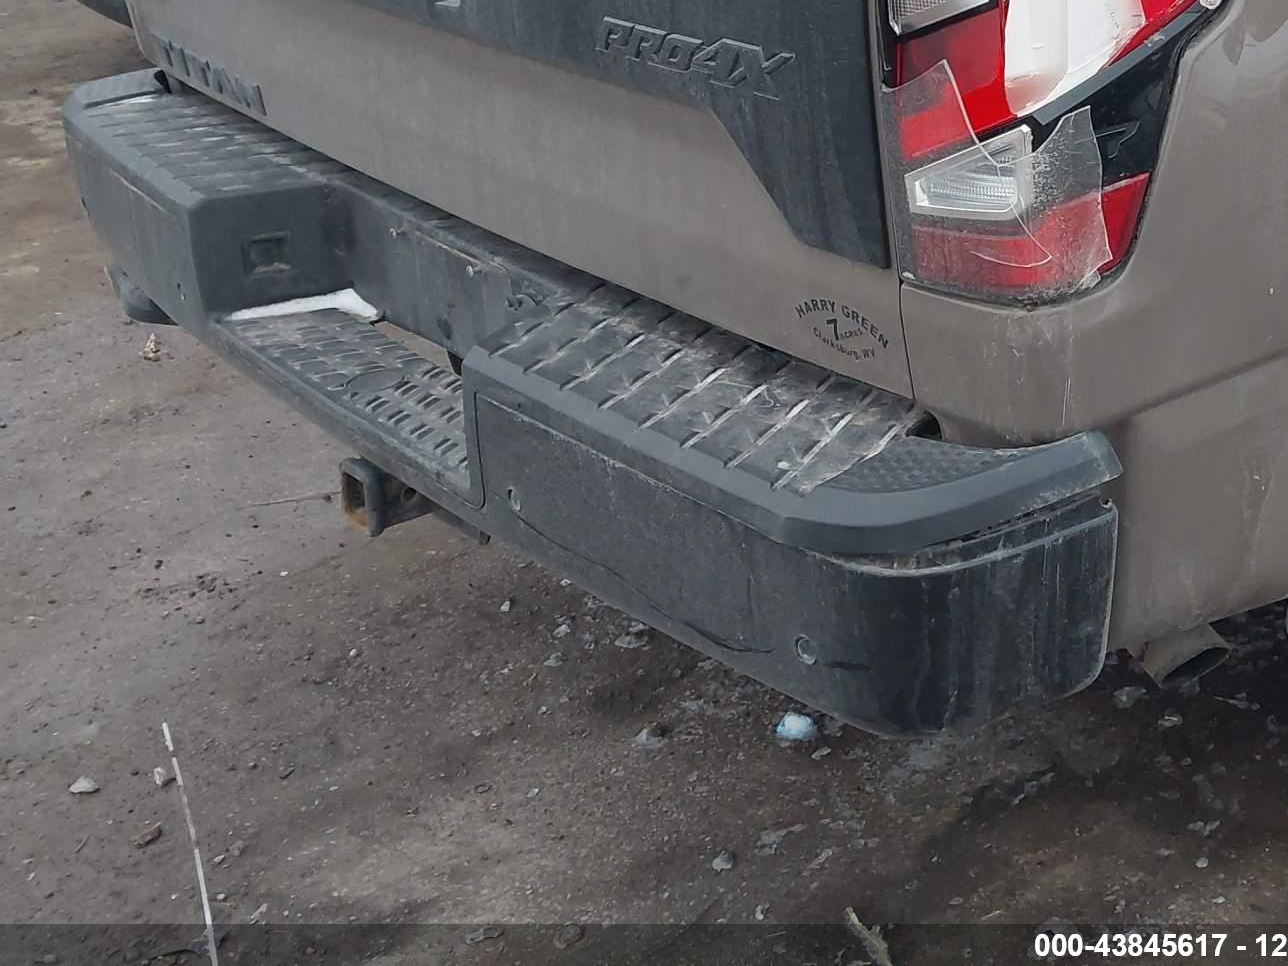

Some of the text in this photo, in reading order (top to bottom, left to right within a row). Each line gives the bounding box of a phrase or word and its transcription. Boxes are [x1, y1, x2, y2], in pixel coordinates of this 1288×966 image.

[795, 299, 888, 349] HARRY GREEN
[826, 318, 839, 341] 7
